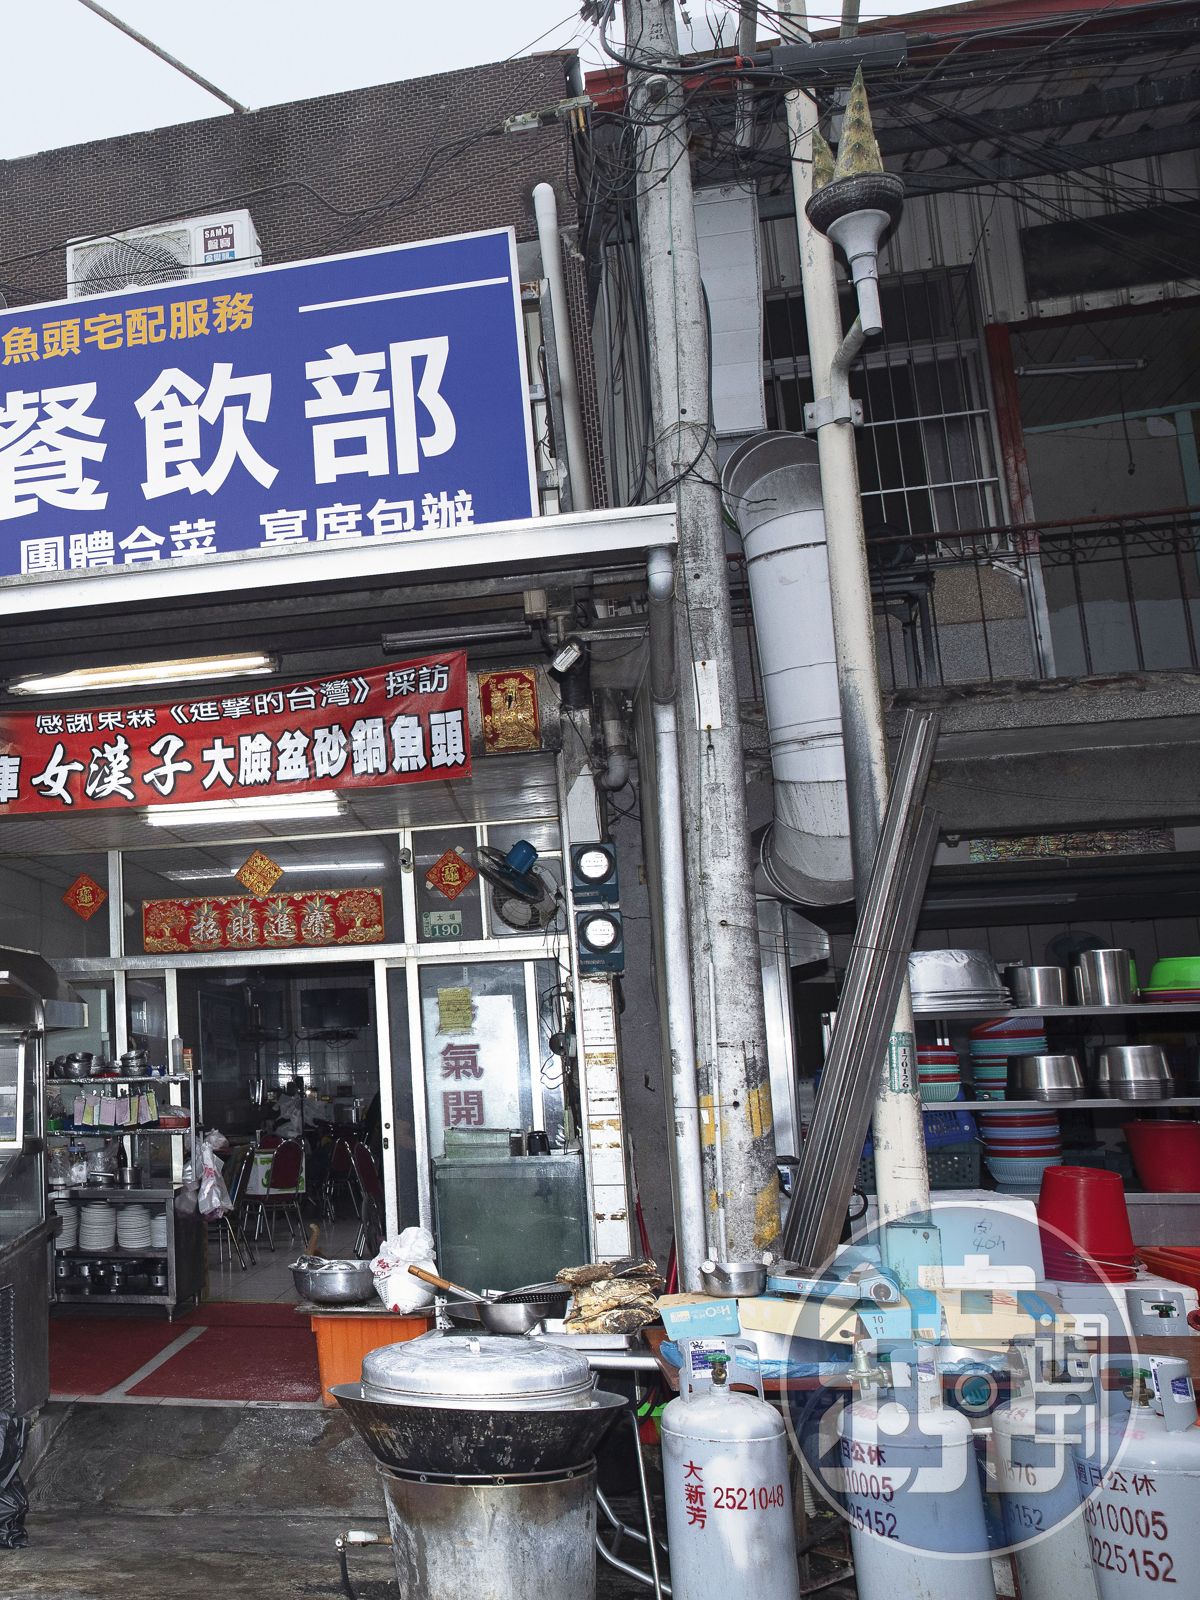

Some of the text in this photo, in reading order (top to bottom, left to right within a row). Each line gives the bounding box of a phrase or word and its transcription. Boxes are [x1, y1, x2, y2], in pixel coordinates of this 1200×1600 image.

[204, 226, 233, 239] SAMPO
[202, 709, 466, 790] 大臉盆砂鍋魚頭
[193, 911, 330, 942] 招財進寶
[433, 924, 460, 936] 190
[438, 1003, 485, 1127] 氣開
[682, 1460, 784, 1529] 大新芳 2521048
